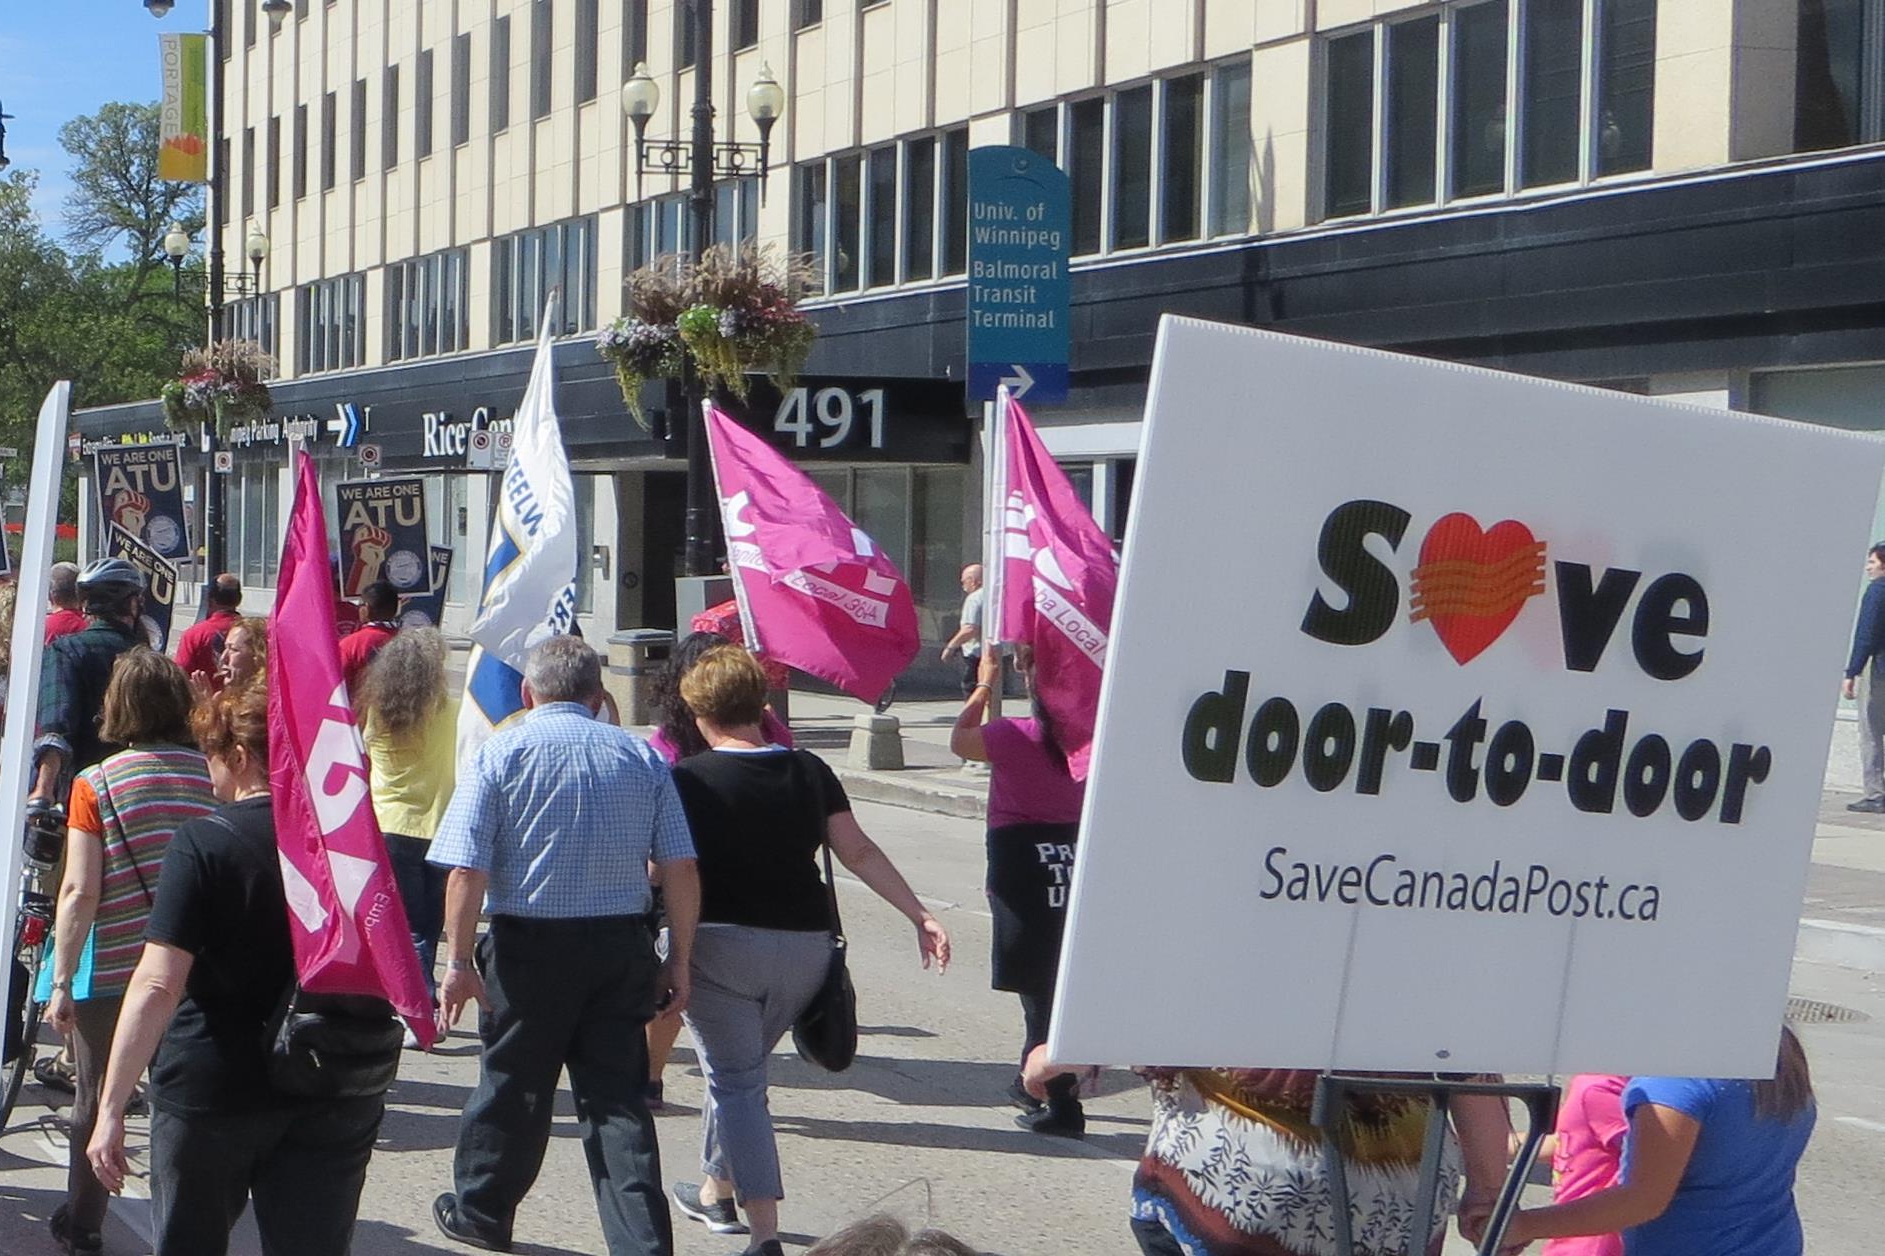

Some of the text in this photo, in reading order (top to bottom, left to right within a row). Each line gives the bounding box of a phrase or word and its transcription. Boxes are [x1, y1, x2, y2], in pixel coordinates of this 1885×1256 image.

[164, 39, 179, 134] PORTAGE
[974, 202, 1045, 221] Univ. of
[975, 225, 1060, 251] Winnipeg
[973, 259, 1058, 280] Balmoral
[973, 284, 1037, 304] Transit
[973, 309, 1055, 329] Terminal
[774, 386, 884, 449] 491
[422, 410, 465, 458] Rice
[101, 449, 174, 465] WE ARE ONE
[104, 461, 176, 495] ATU
[341, 484, 420, 499] WE ARE ONE
[344, 496, 422, 531] ATU
[114, 532, 131, 550] WE
[132, 547, 153, 565] ARE
[154, 561, 174, 584] ONE
[432, 552, 449, 563] NE
[790, 571, 846, 601] Local
[1054, 608, 1106, 656] Local
[1181, 669, 1772, 825] door-to-door
[1035, 842, 1077, 863] PR
[1259, 846, 1661, 922] SaveCanadaPost.ca
